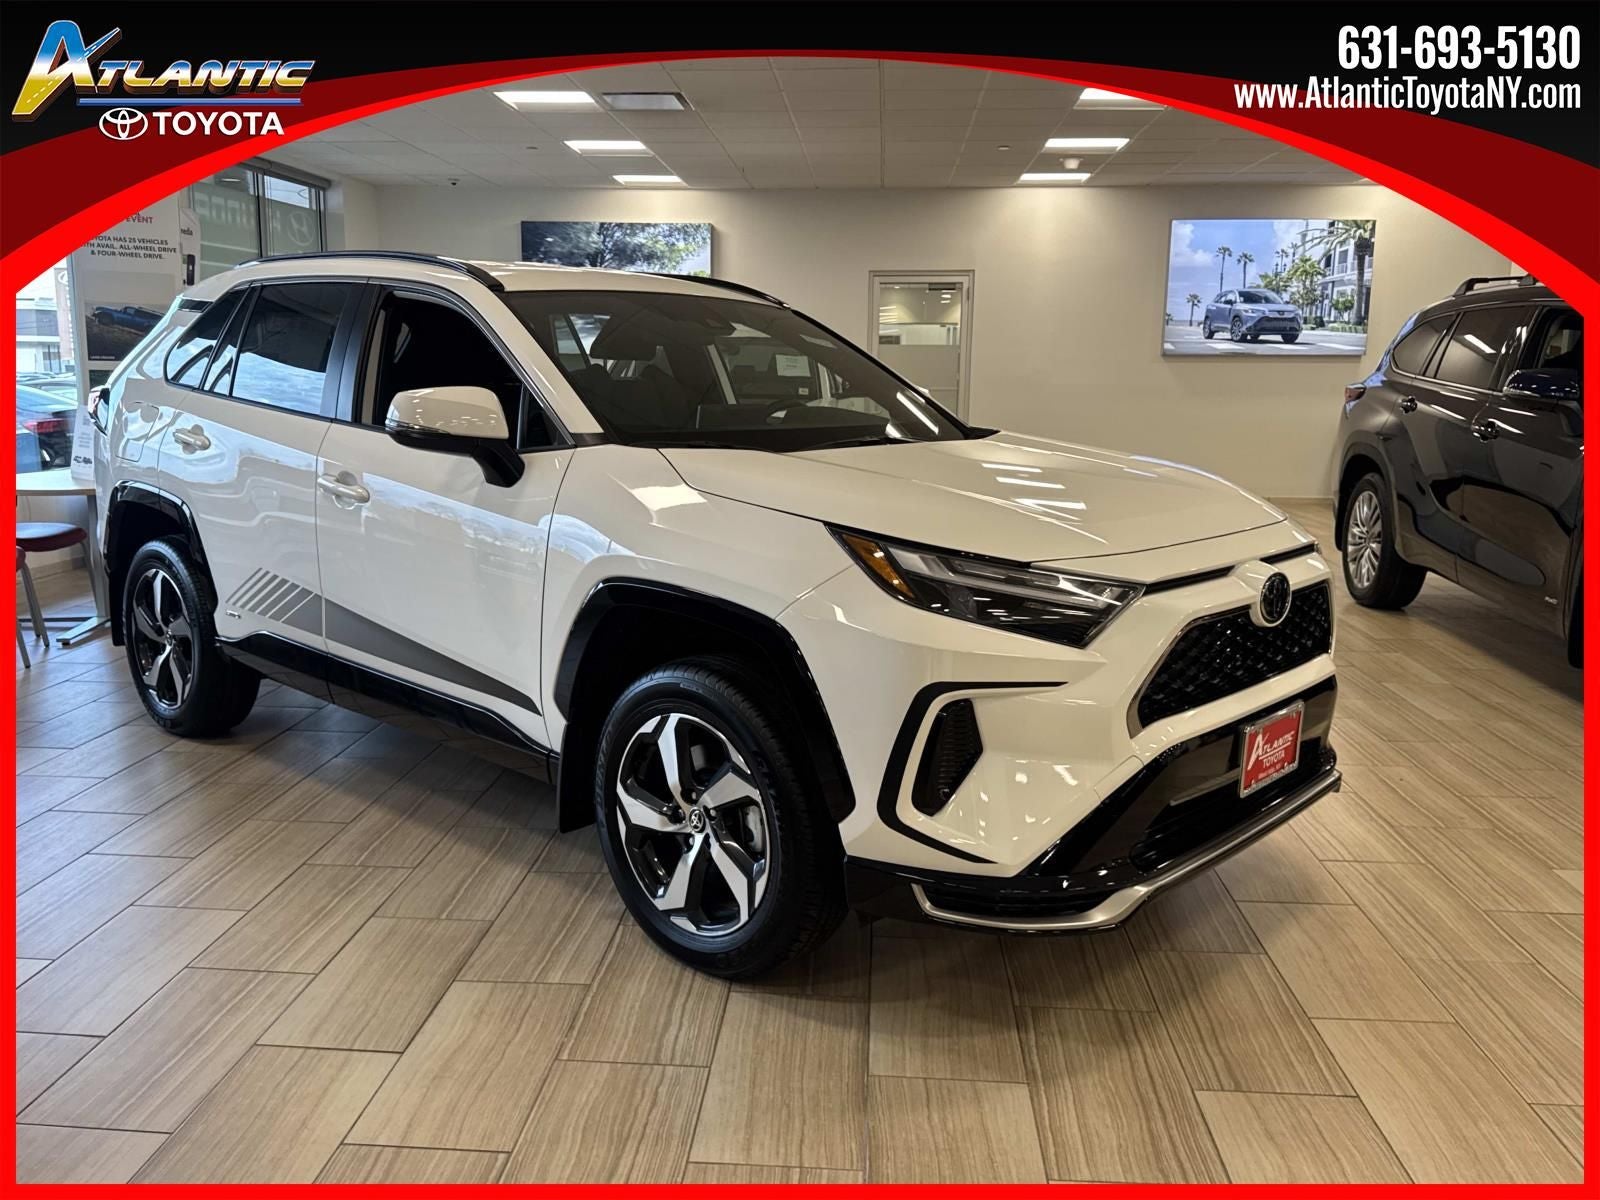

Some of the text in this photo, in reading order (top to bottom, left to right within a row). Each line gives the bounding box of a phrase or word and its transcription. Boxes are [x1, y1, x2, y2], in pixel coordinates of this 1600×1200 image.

[137, 238, 169, 246] VEHICLES
[119, 244, 157, 253] ALL-WHEEL
[157, 246, 177, 254] DRIVE
[1263, 750, 1285, 768] TOYOTA
